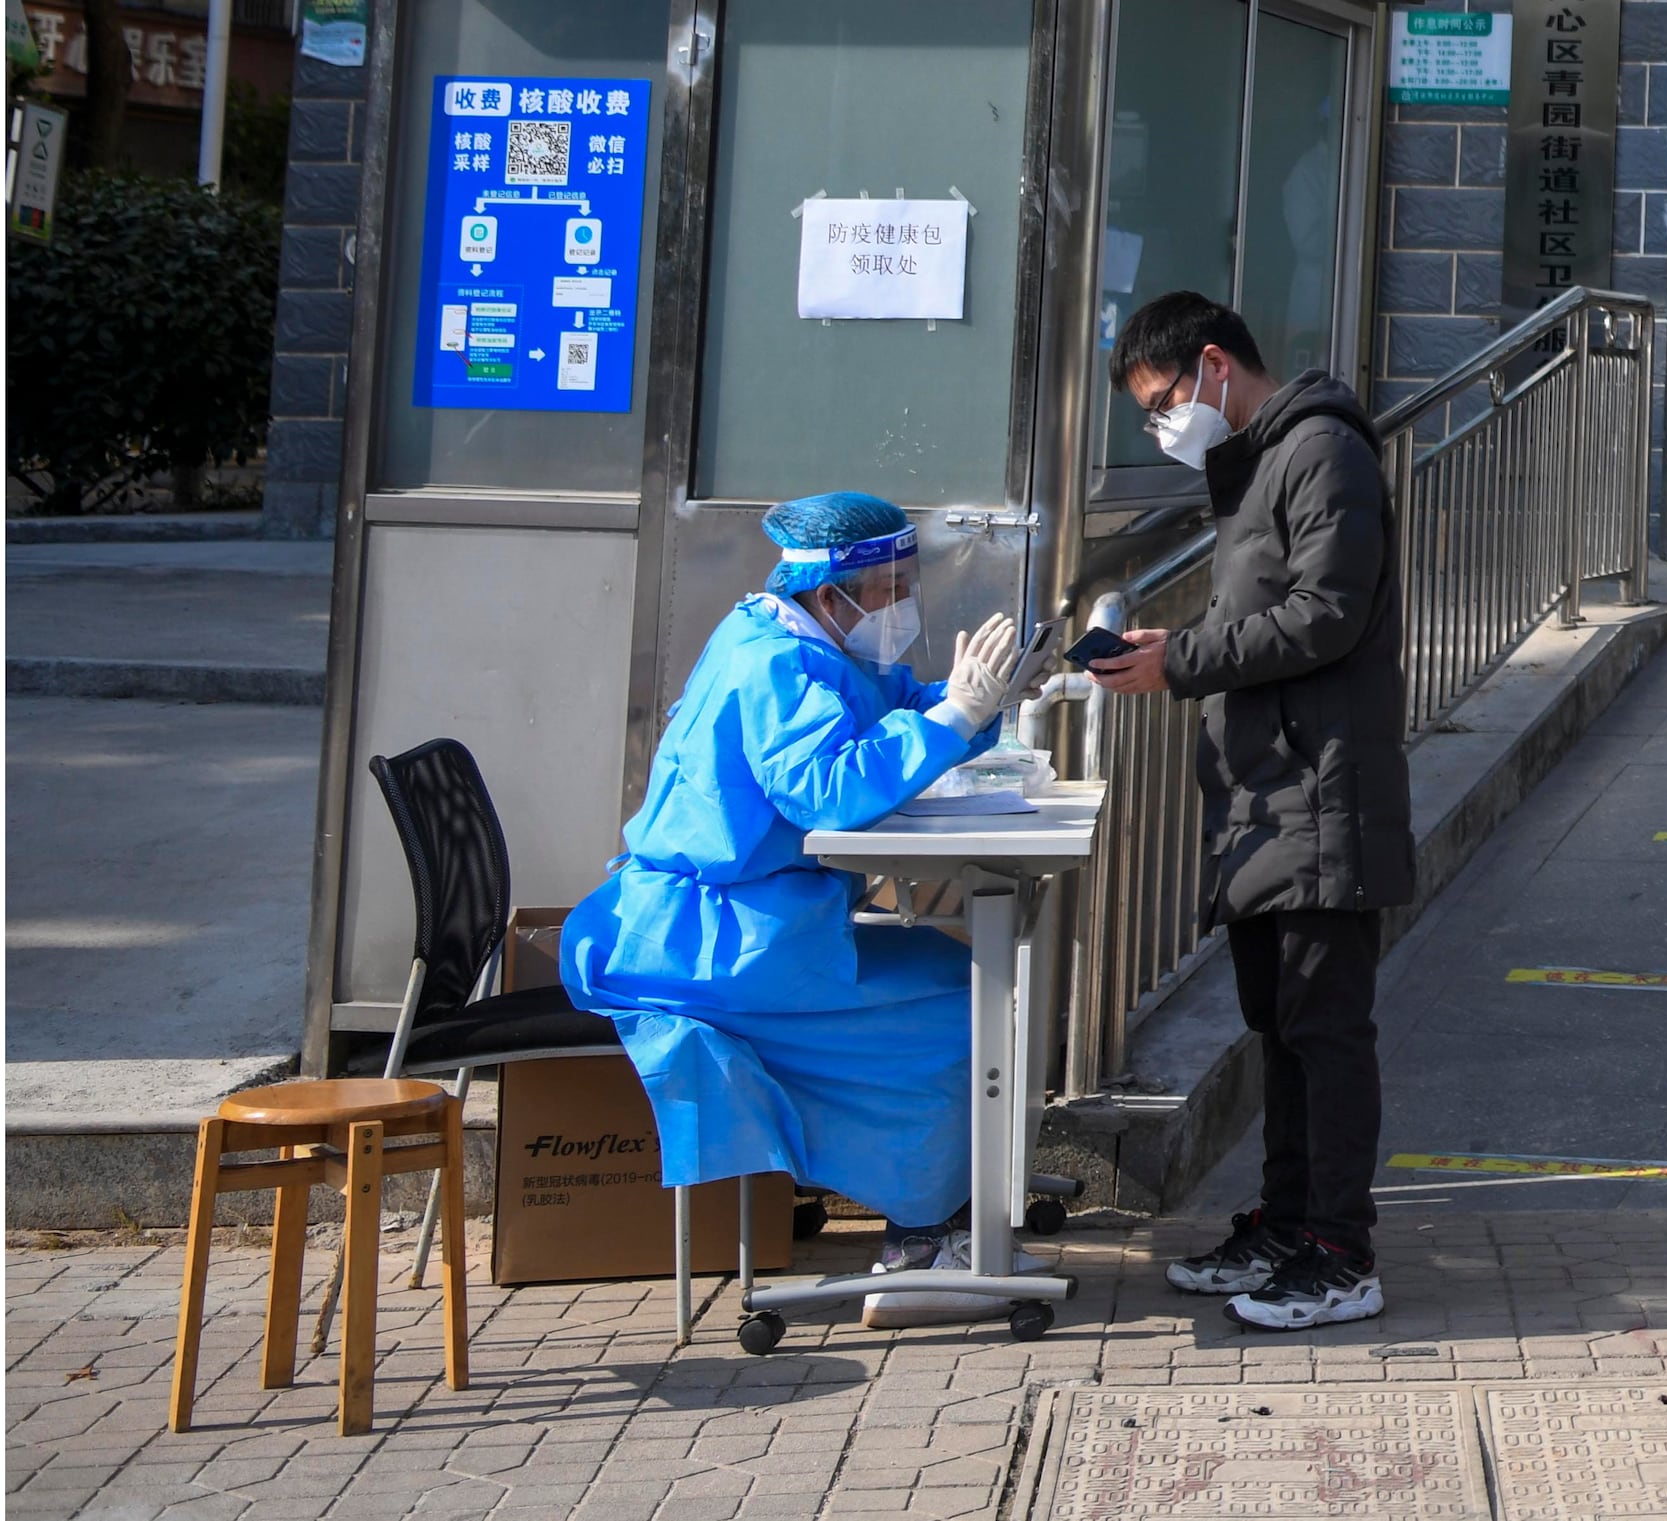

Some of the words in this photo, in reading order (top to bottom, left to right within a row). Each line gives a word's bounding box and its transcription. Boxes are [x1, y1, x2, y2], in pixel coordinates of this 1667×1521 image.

[454, 87, 503, 111] 收费
[519, 88, 632, 116] 核酸收费
[453, 131, 492, 151] 核酸
[588, 135, 627, 154] 微信
[453, 153, 492, 173] 采样
[587, 157, 625, 176] 必扫
[828, 223, 942, 246] 防疫健康包
[850, 253, 919, 276] 领取处
[524, 1133, 646, 1160] Flowflex
